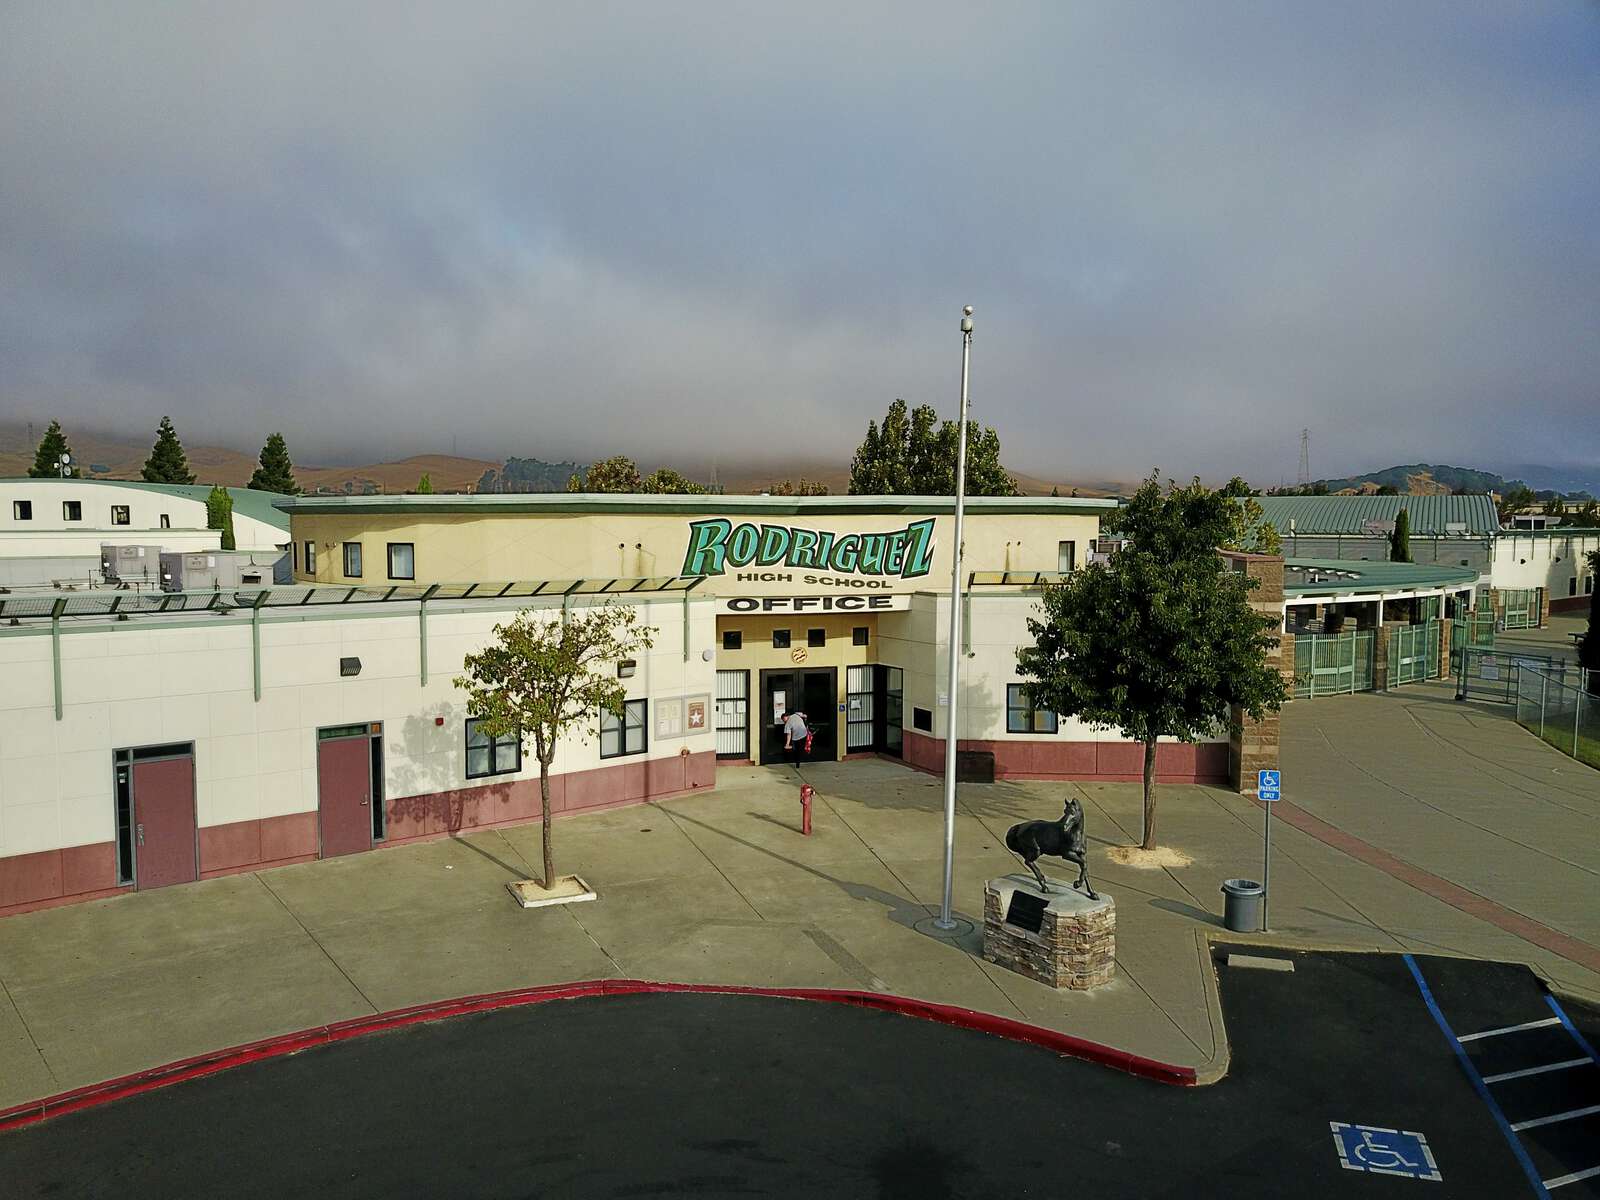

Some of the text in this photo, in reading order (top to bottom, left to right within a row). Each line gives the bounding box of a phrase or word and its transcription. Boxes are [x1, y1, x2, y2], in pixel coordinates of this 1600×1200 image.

[681, 517, 936, 579] RODRIGUEZ
[737, 573, 893, 589] HIGH SCHOOL
[726, 596, 893, 612] OFFICE
